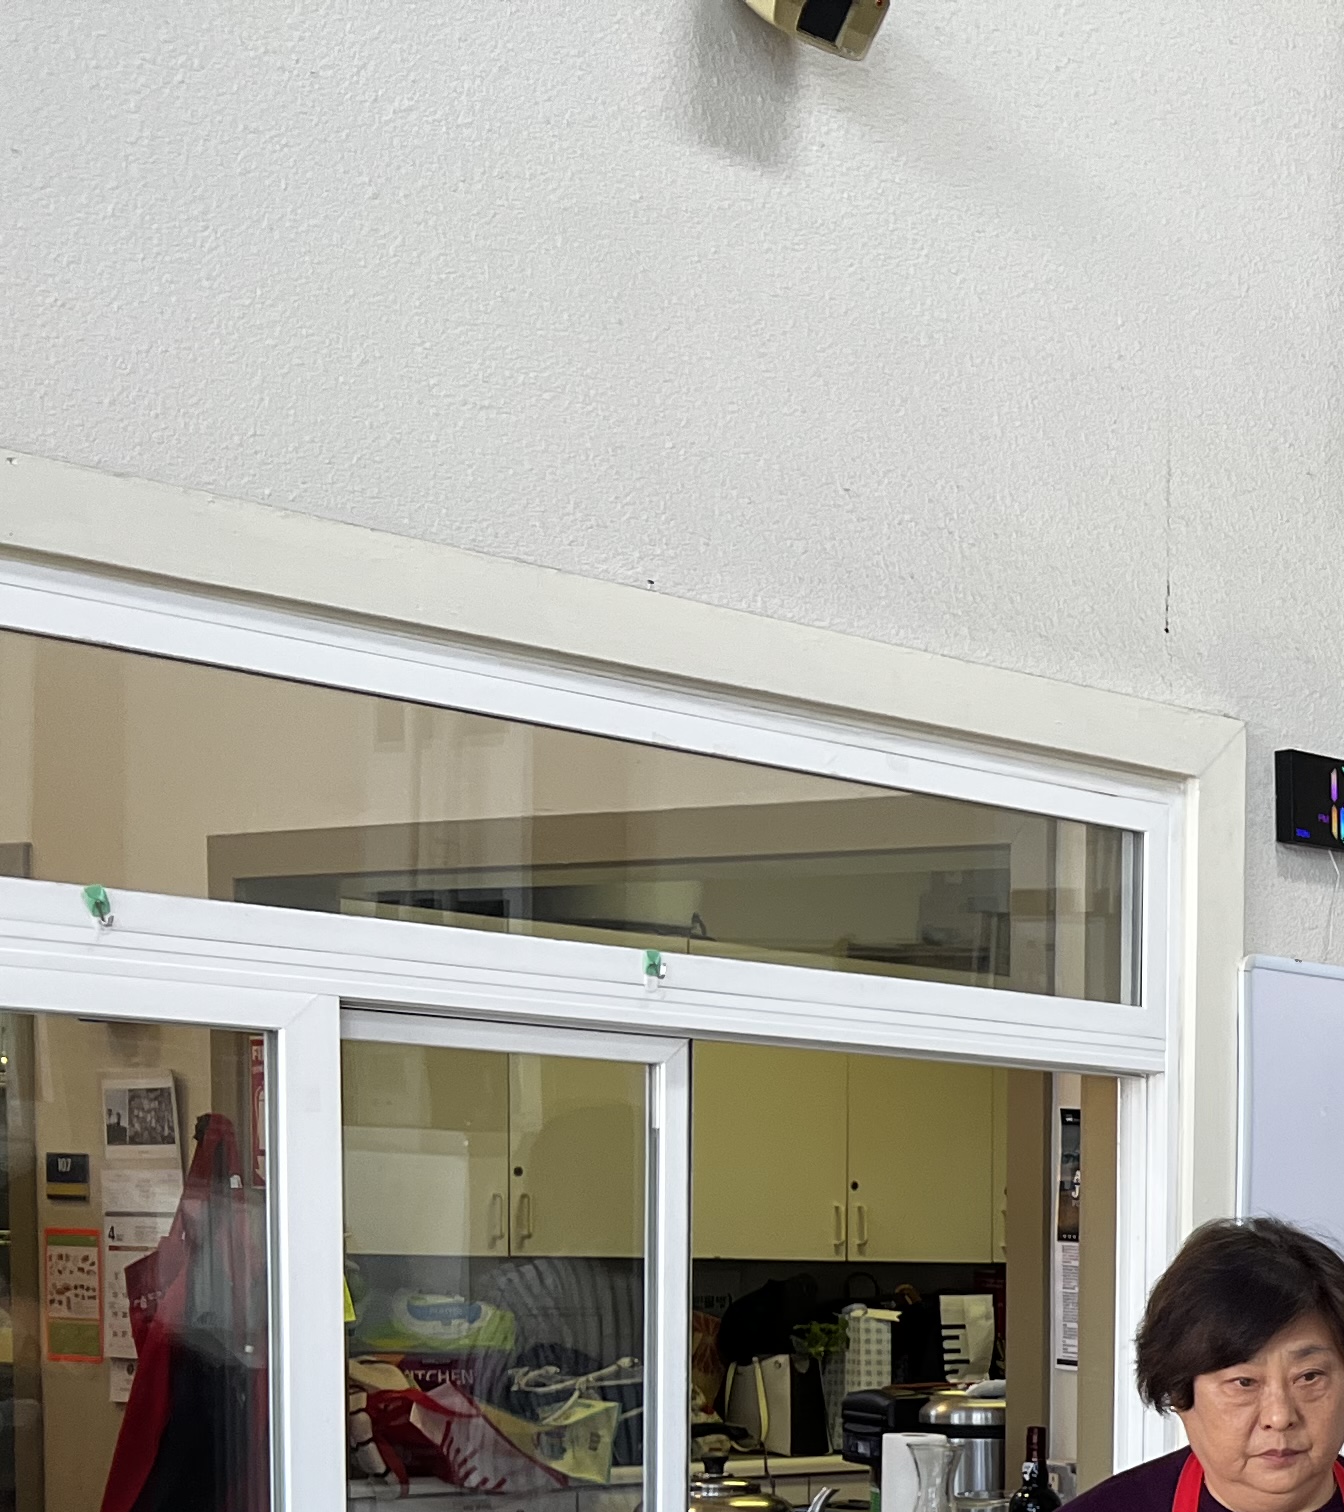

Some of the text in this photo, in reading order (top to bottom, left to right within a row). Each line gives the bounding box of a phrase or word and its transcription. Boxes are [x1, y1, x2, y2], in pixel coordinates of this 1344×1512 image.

[57, 1157, 72, 1173] 107
[107, 1225, 116, 1242] 4
[404, 1369, 474, 1385] ITCHEN
